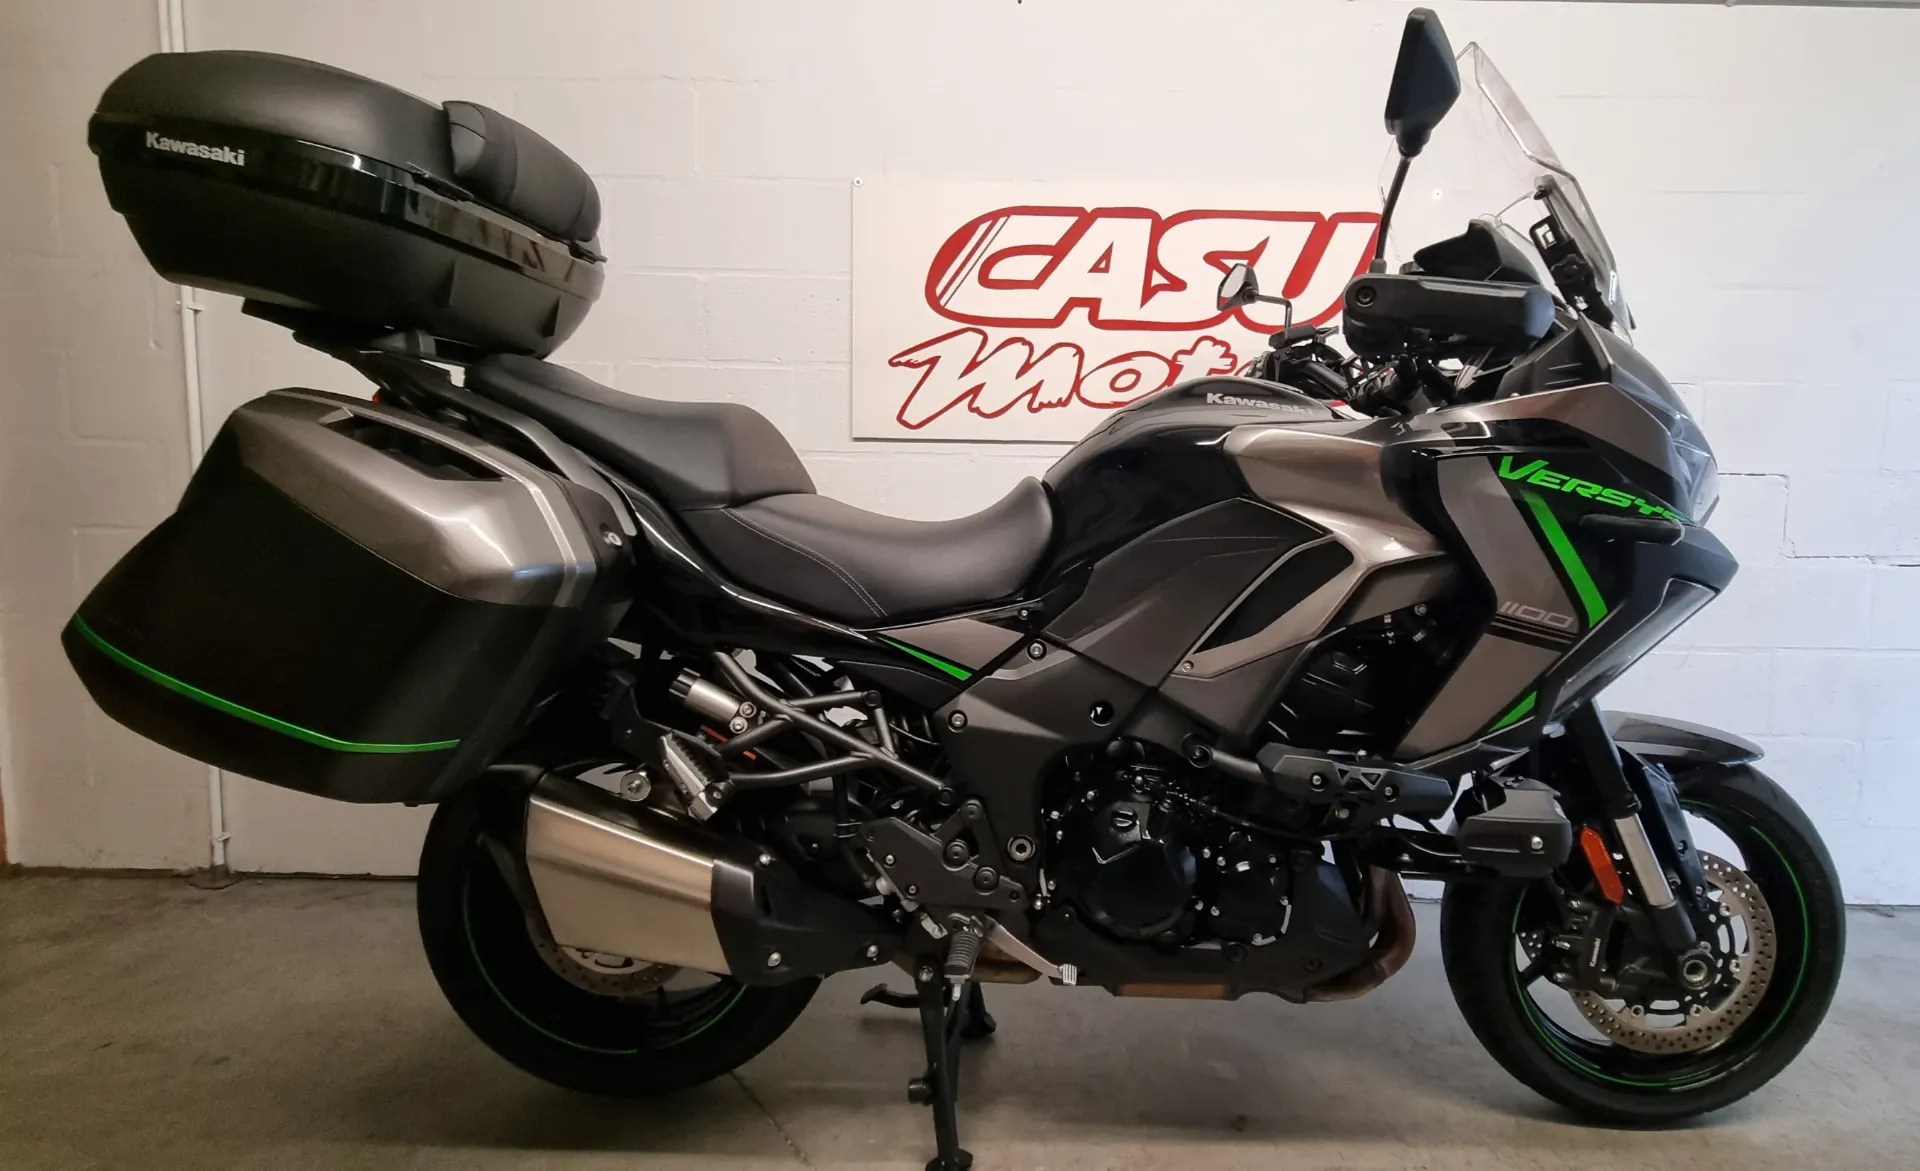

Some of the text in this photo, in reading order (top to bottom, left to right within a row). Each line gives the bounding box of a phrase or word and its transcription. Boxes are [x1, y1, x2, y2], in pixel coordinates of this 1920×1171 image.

[146, 131, 245, 167] Kawasaki
[925, 205, 1383, 334] CASU
[1206, 392, 1313, 415] Kawasaki
[1500, 601, 1573, 628] 1100
